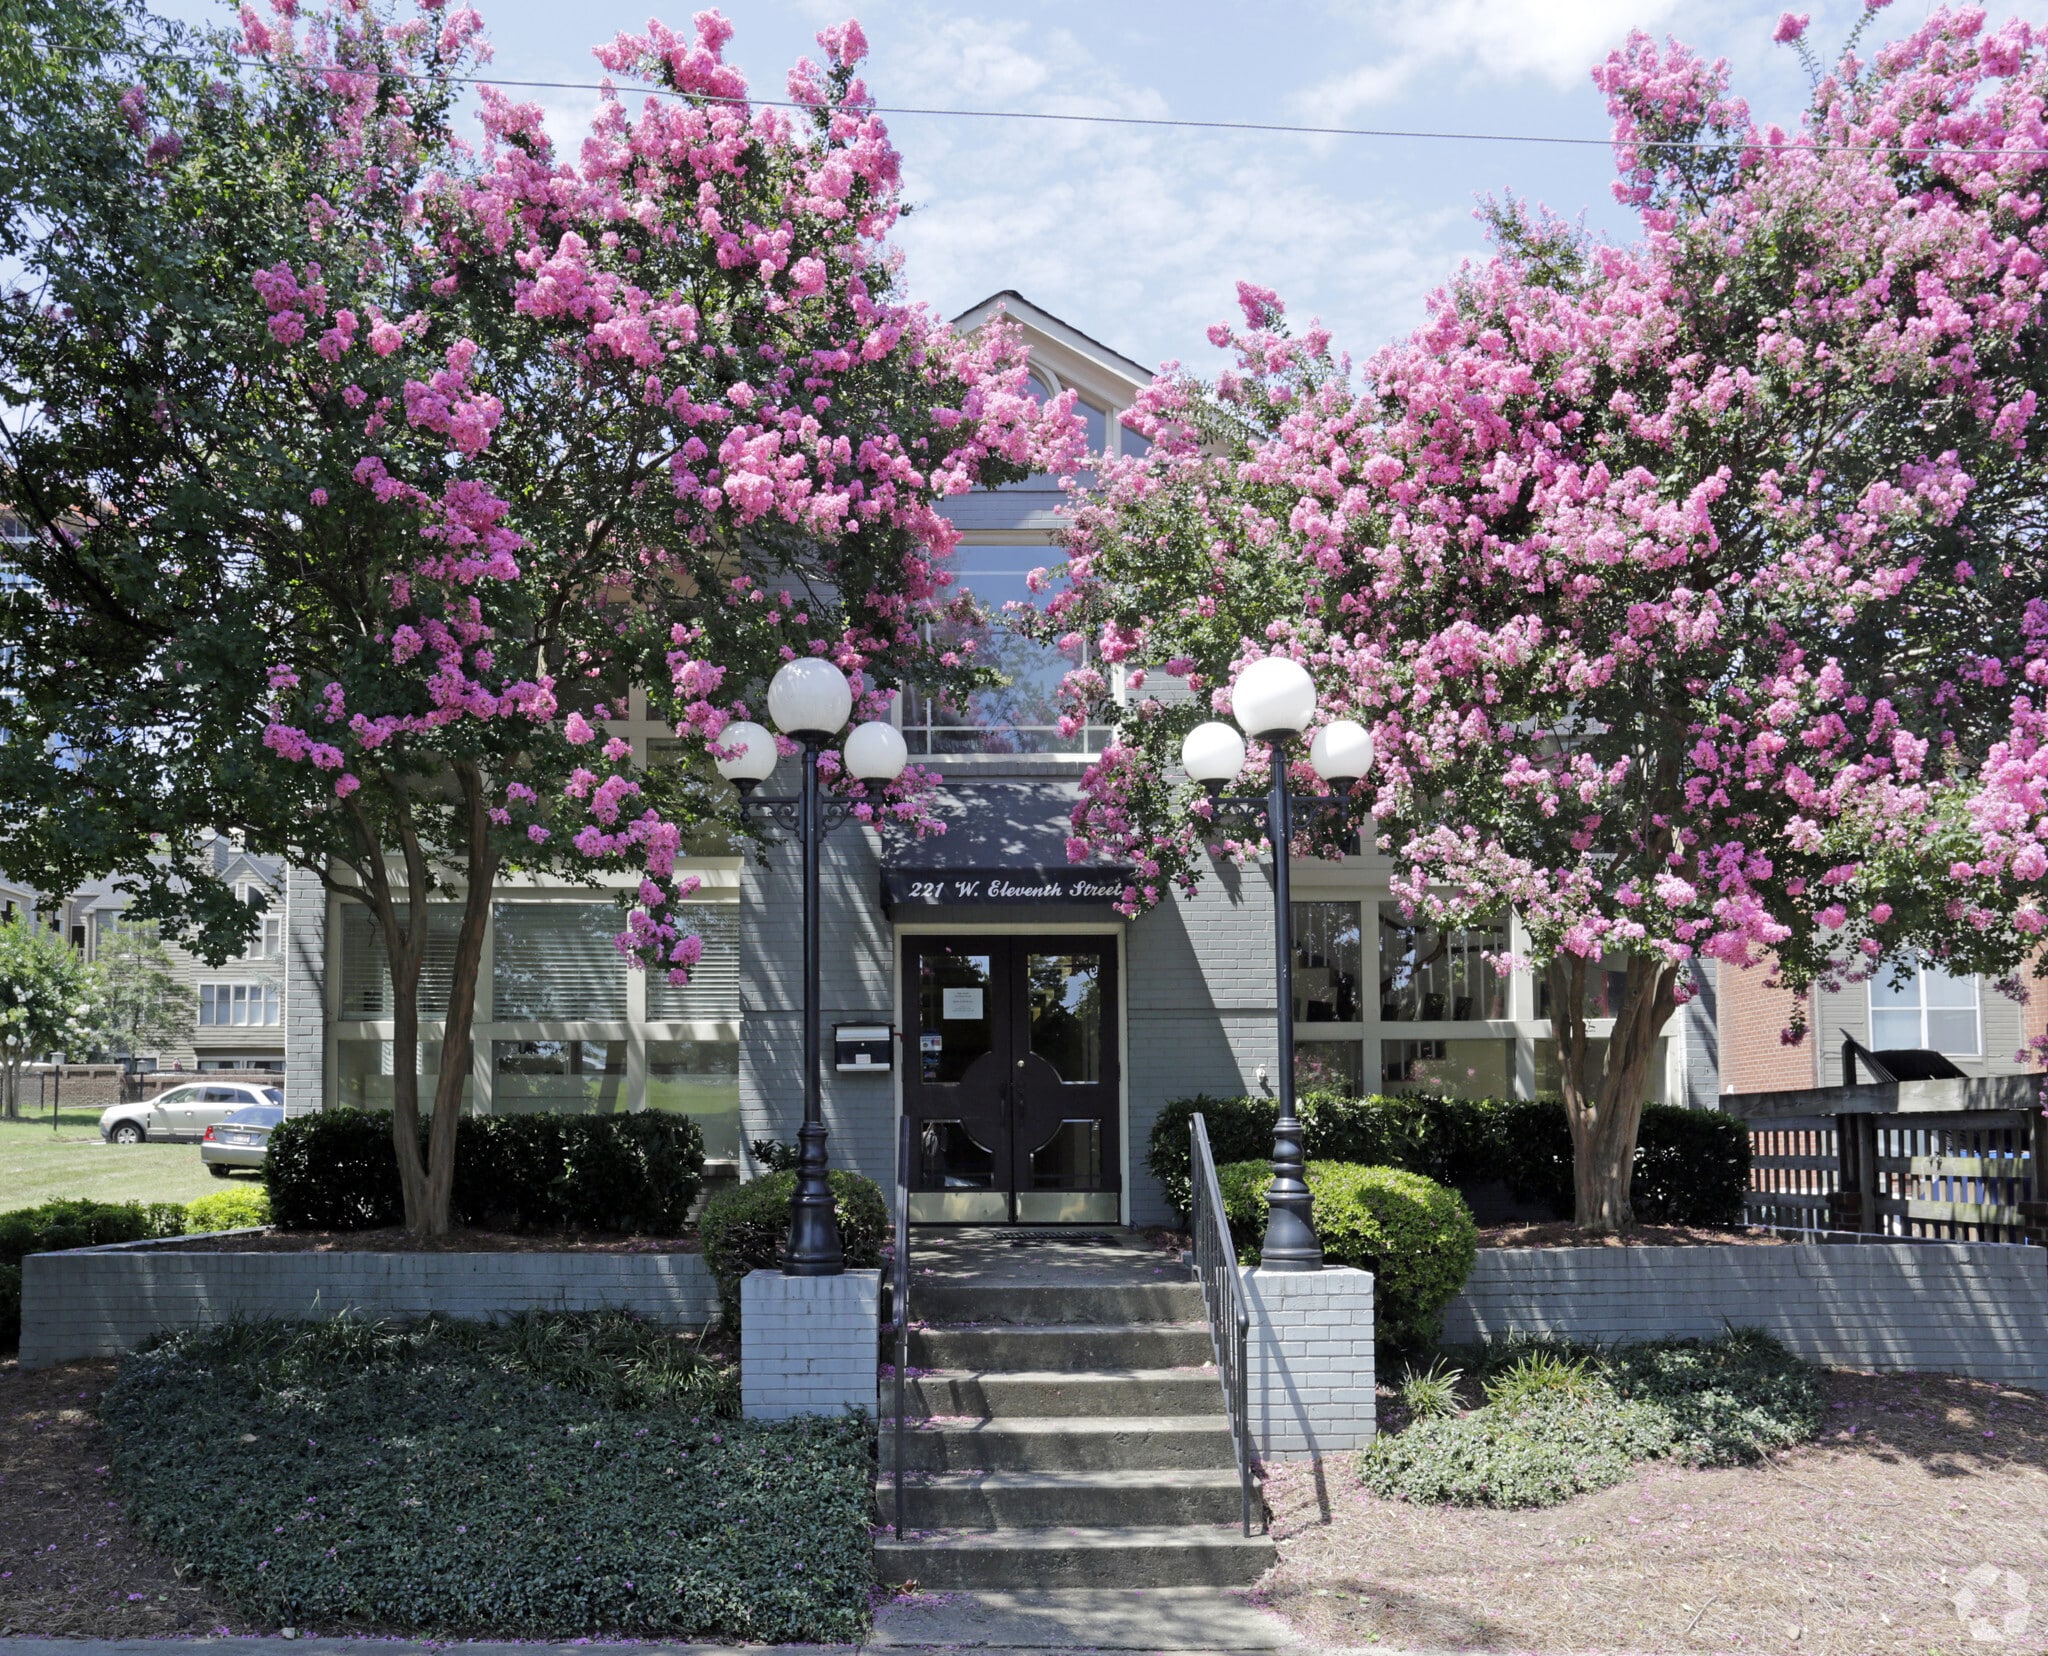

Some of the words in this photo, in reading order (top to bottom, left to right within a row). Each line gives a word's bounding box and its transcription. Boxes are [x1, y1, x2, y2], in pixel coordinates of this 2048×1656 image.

[908, 881, 945, 898] 221
[955, 880, 980, 897] W.
[987, 880, 1063, 898] Eleventh
[1069, 879, 1123, 897] Street
